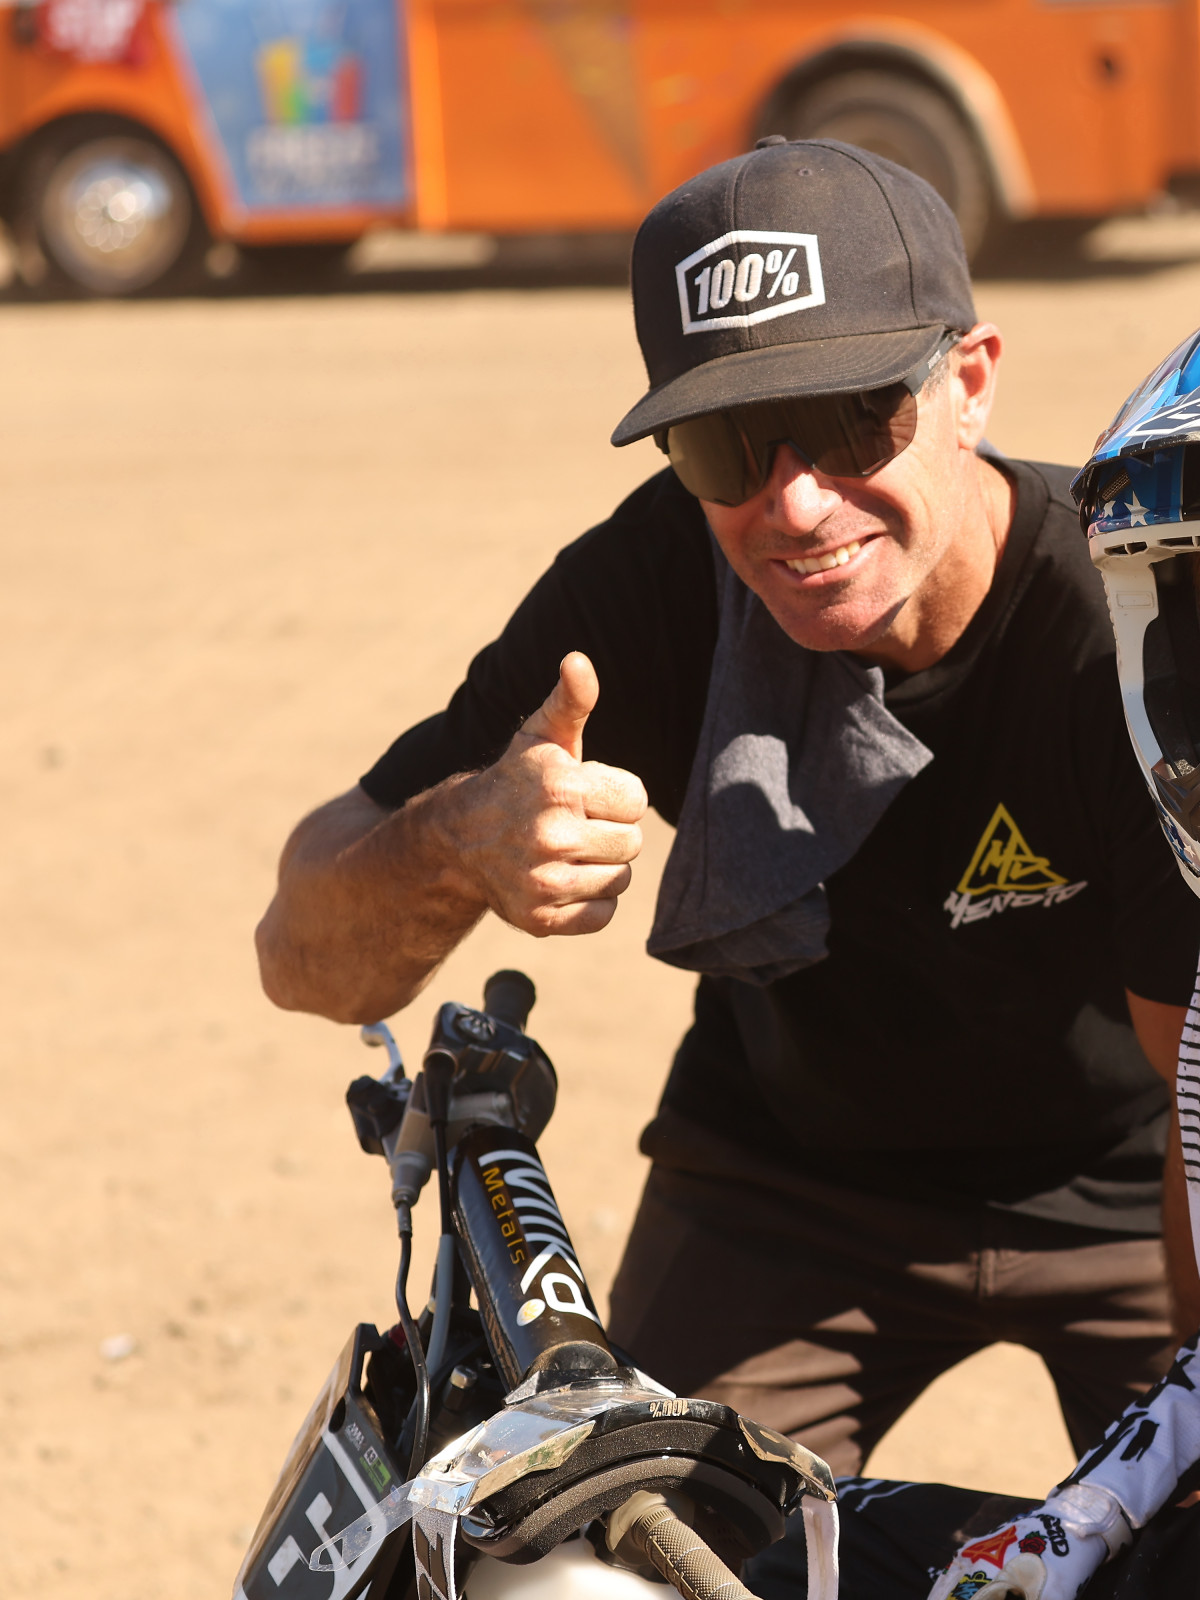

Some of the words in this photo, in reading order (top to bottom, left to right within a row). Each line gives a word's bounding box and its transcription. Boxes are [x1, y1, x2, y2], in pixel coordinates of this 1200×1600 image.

[694, 247, 799, 316] 100%
[481, 1166, 526, 1267] Metals
[649, 1399, 690, 1418] 100%
